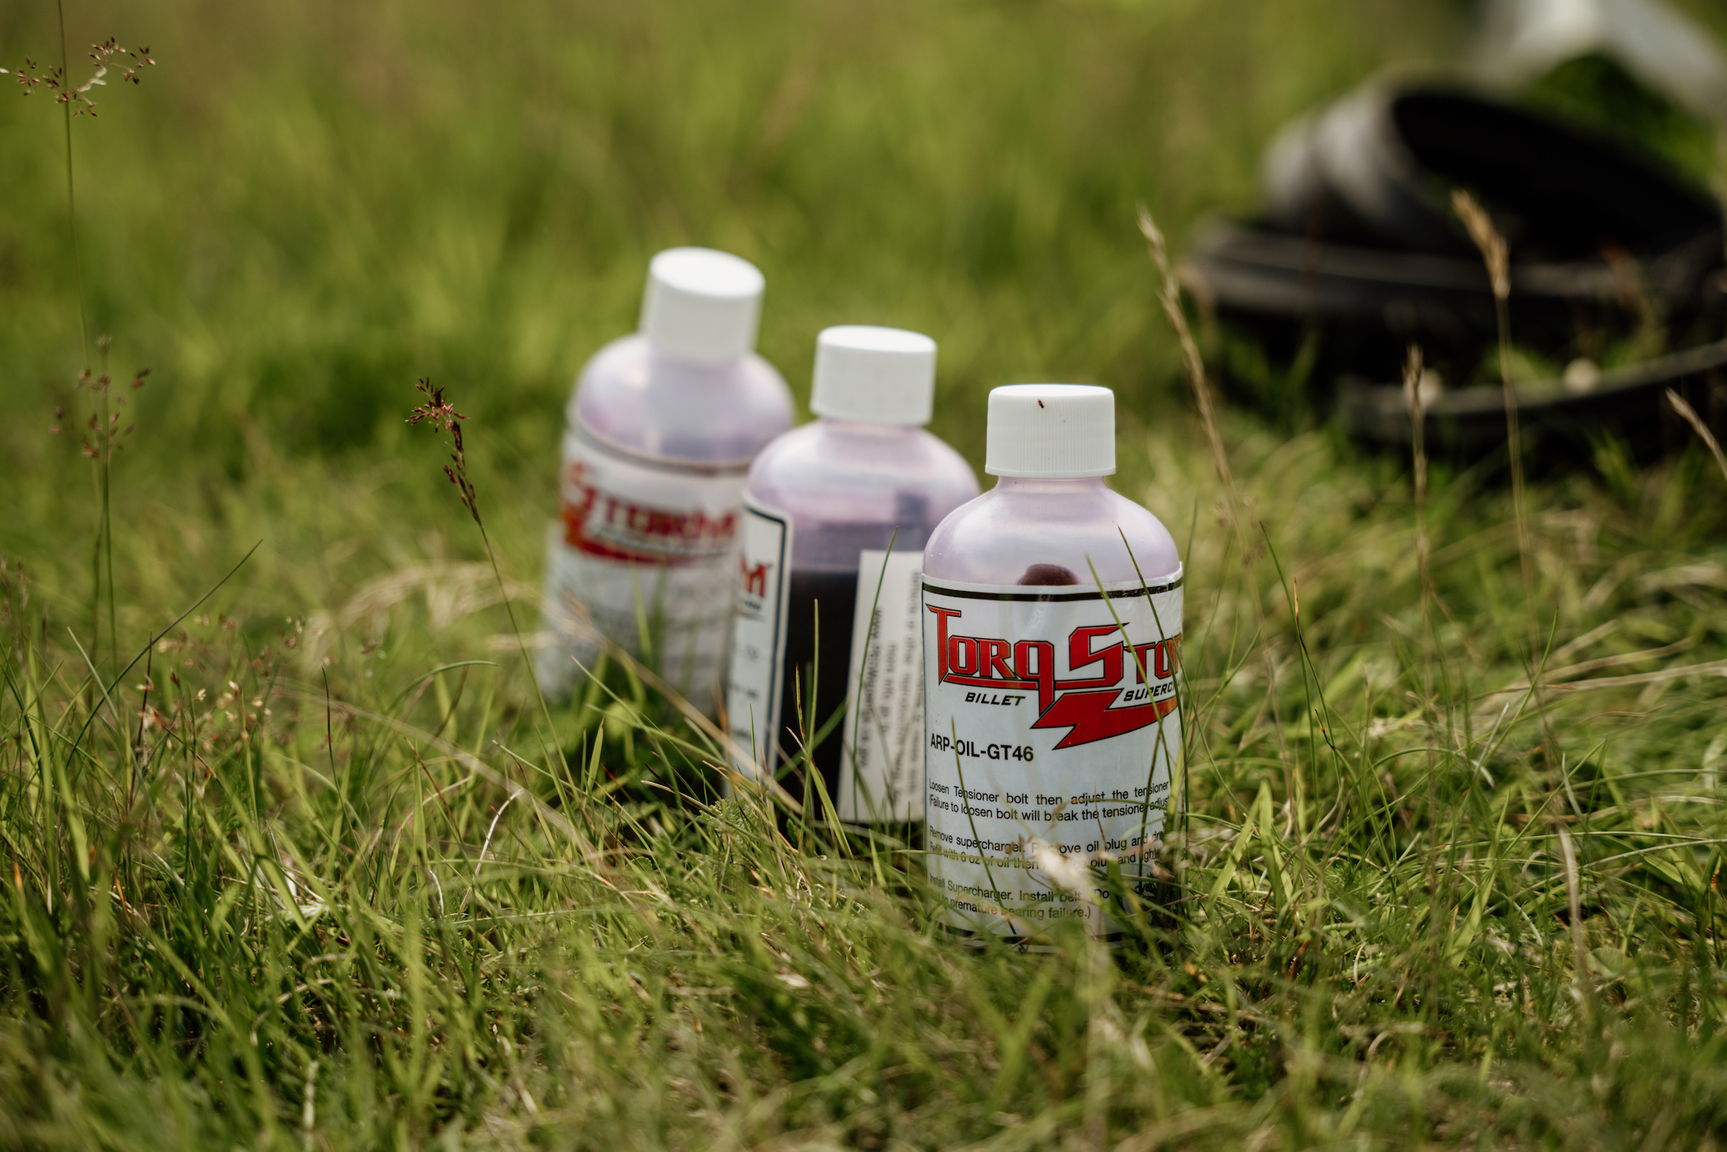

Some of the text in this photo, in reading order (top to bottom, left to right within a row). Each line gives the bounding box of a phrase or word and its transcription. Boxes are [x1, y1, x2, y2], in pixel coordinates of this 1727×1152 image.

[965, 692, 1026, 706] BILLET
[930, 733, 1034, 762] ARP-OIL-GT46
[929, 778, 1169, 806] Loosen Tensioner bolt then adjust the tensioner
[929, 794, 949, 810] Failure
[951, 802, 959, 813] to
[961, 803, 993, 818] loosen
[996, 808, 1018, 819] bolt
[1021, 810, 1040, 821] will
[1044, 810, 1079, 821] beak
[1082, 809, 1099, 820] the
[1102, 803, 1147, 818] tensione
[929, 825, 953, 843] Remove
[1031, 841, 1081, 856] Rove
[1086, 840, 1099, 852] oil
[1104, 838, 1127, 853] plug
[1131, 832, 1148, 847] and
[943, 848, 959, 861] with
[997, 857, 1010, 868] oil
[1014, 857, 1039, 870] then
[1118, 852, 1136, 865] and
[947, 880, 1014, 902] Supercharger.
[1020, 889, 1054, 902] Install
[950, 898, 998, 915] premature
